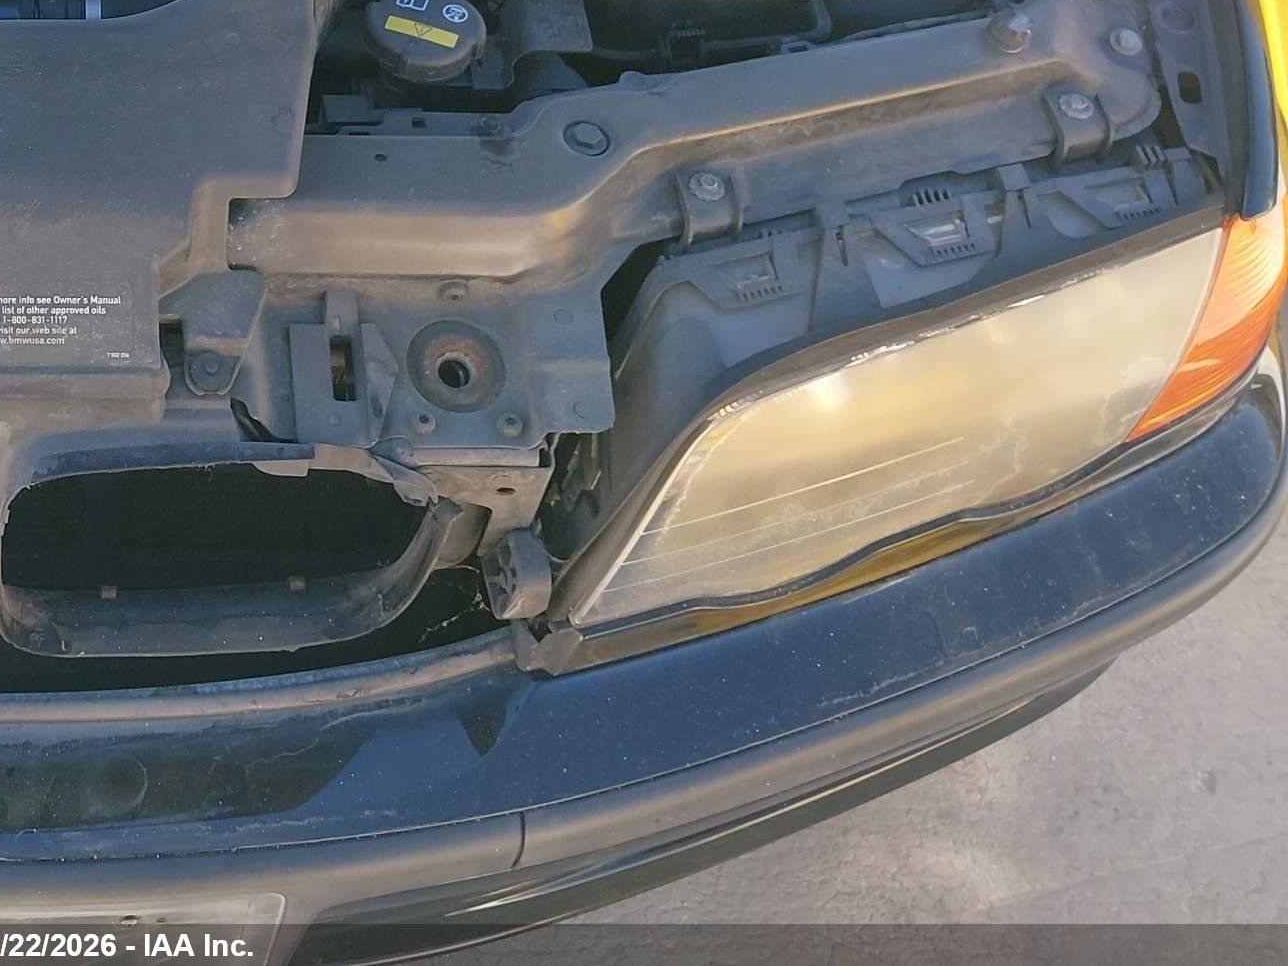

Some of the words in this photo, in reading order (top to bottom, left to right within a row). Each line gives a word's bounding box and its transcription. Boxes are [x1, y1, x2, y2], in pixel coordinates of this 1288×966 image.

[19, 295, 35, 304] info
[53, 295, 88, 304] Owner's
[90, 295, 121, 304] Manual
[2, 306, 15, 314] list
[16, 306, 25, 314] of
[26, 306, 49, 314] other
[50, 306, 90, 316] approved
[91, 306, 106, 315] oils
[2, 316, 68, 324] 1-800-831-1117
[32, 326, 50, 334] web
[51, 326, 67, 334] site
[69, 326, 78, 334] at
